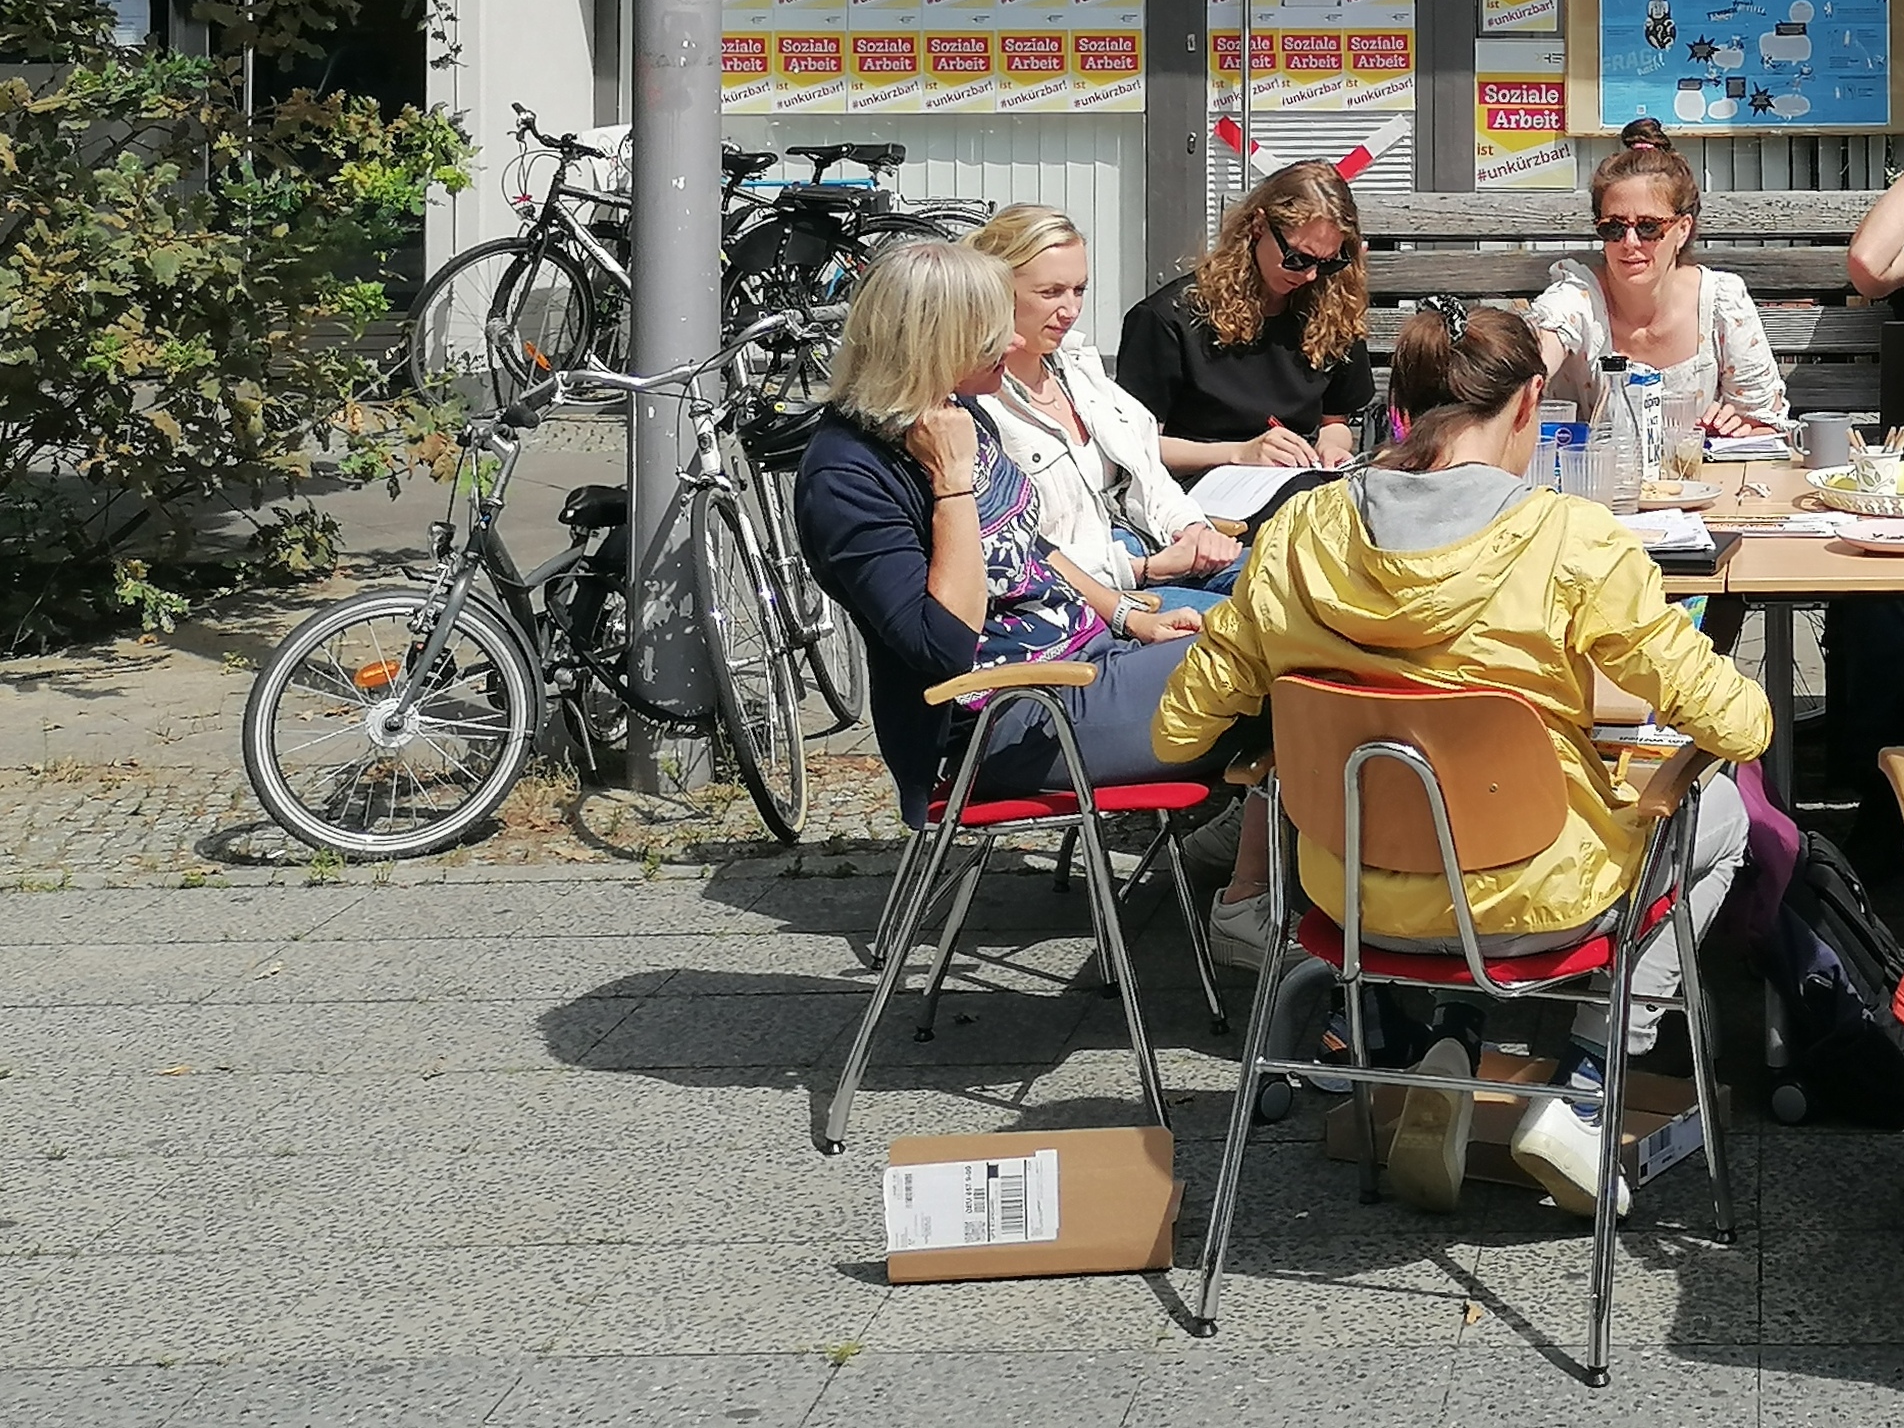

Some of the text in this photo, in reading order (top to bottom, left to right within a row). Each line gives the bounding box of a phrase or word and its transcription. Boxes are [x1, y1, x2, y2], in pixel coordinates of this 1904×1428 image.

[1487, 0, 1555, 28] #unkürzbar!
[783, 39, 837, 53] Soziale
[857, 39, 911, 53] Soziale
[931, 39, 985, 53] Soziale
[1005, 38, 1059, 52] Soziale
[1078, 38, 1132, 52] Soziale
[1283, 36, 1338, 51] Soziale
[1351, 36, 1404, 50] Soziale
[788, 57, 837, 71] Arbeit
[863, 57, 912, 71] Arbeit
[937, 57, 986, 71] Arbeit
[1011, 56, 1060, 70] Arbeit
[1084, 56, 1133, 70] Arbeit
[1290, 55, 1339, 68] Arbeit
[1357, 54, 1406, 68] Arbeit
[1484, 85, 1559, 103] Soziale
[1492, 109, 1561, 129] Arbeit
[1477, 142, 1494, 156] ist
[1477, 143, 1571, 183] #unkürzbar!
